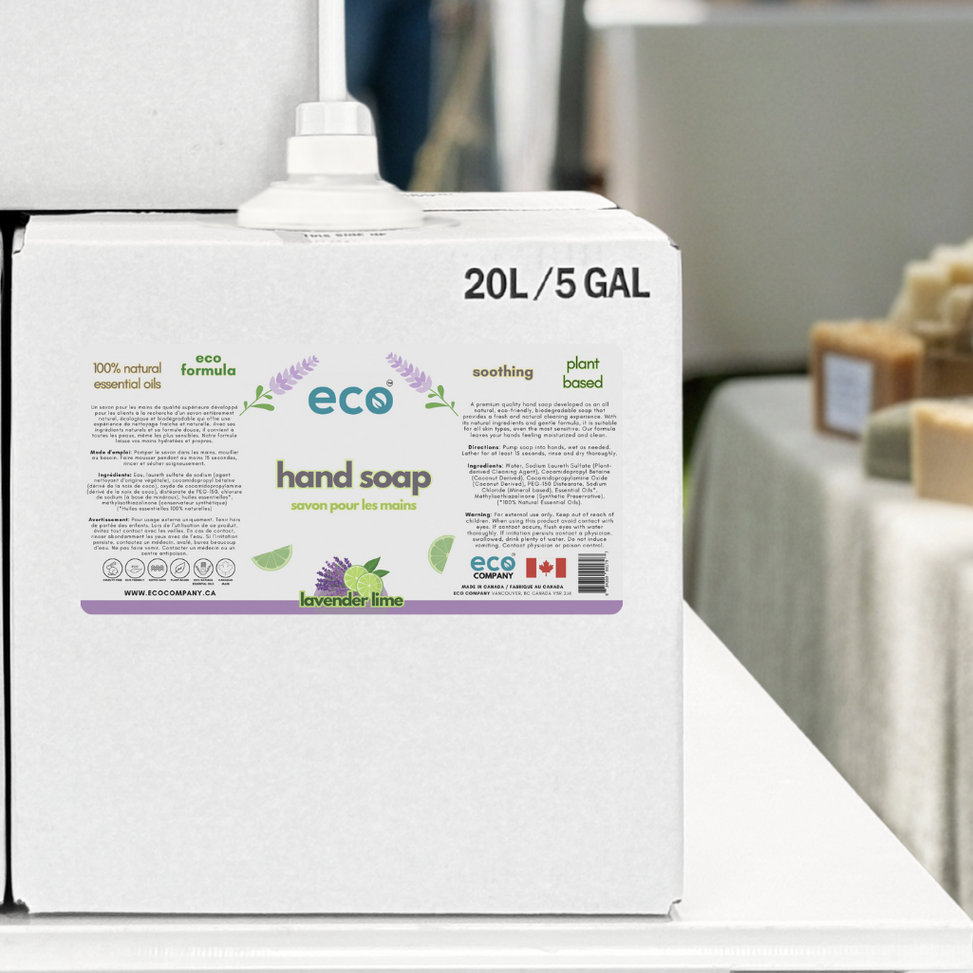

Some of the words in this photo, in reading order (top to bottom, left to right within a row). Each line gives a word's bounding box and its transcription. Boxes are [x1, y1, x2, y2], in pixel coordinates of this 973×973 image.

[584, 267, 650, 298] GAL
[195, 354, 222, 364] eco
[566, 355, 600, 374] plant
[93, 362, 121, 374] 100%
[123, 361, 162, 374] natural
[180, 363, 236, 376] formula
[472, 364, 534, 381] soothing
[93, 377, 141, 389] essential
[143, 377, 162, 389] oils
[563, 374, 603, 389] based
[308, 385, 393, 415] eco
[276, 459, 354, 490] hand
[358, 469, 433, 497] soap
[291, 502, 328, 511] savon
[330, 502, 360, 514] pour
[361, 498, 378, 511] les
[380, 498, 417, 511] mains
[470, 556, 516, 572] eco
[473, 571, 513, 580] COMPANY
[299, 590, 368, 608] lavender
[369, 590, 405, 608] lime
